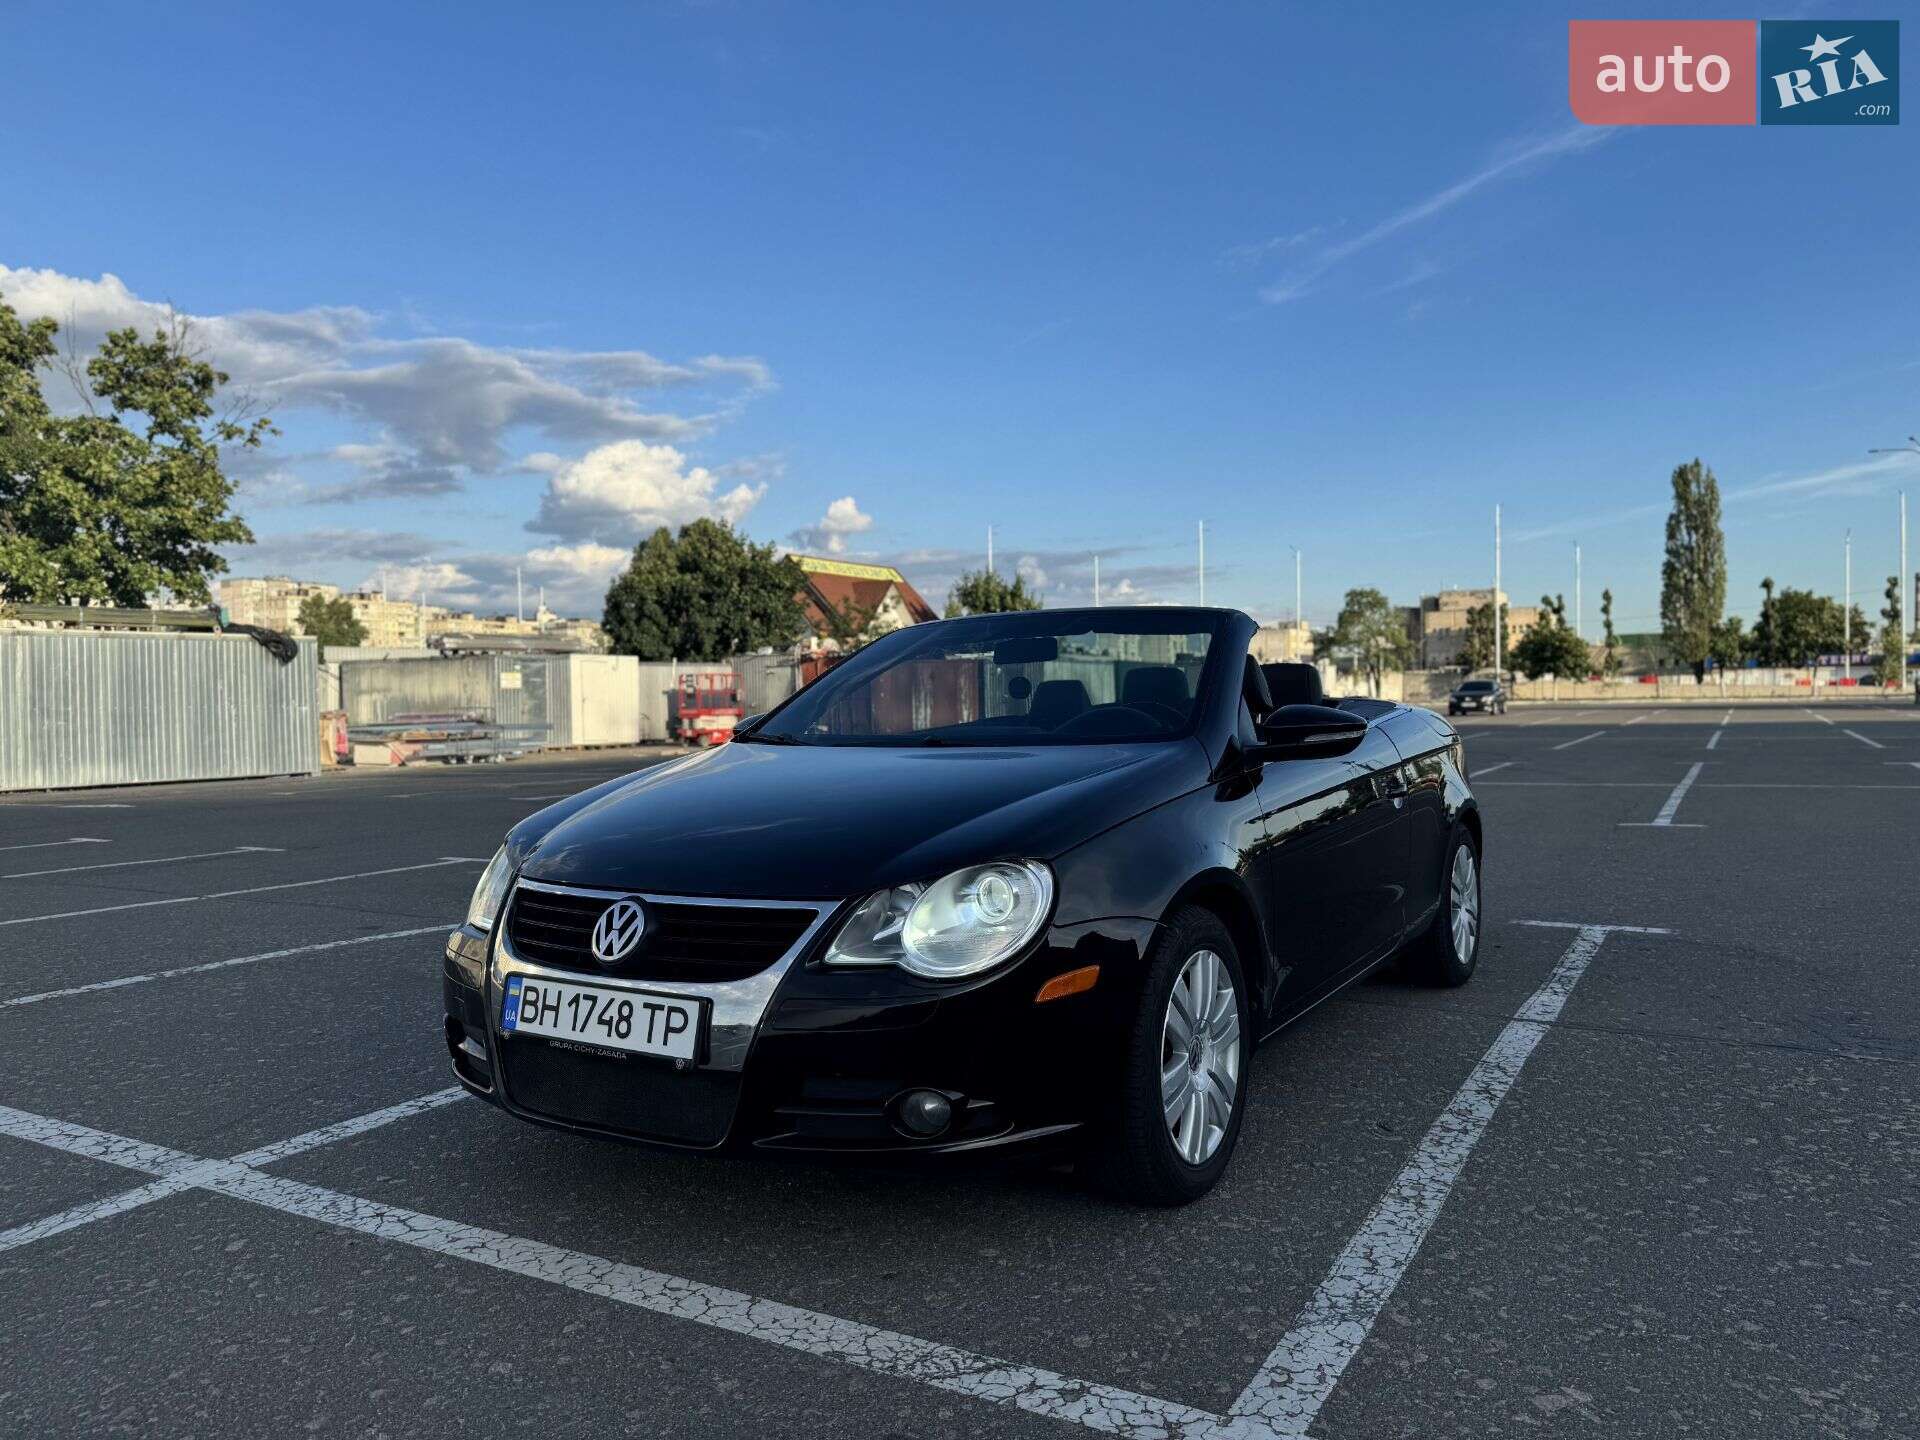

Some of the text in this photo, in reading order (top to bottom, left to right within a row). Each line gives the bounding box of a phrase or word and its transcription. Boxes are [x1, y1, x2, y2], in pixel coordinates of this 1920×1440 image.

[505, 1009, 516, 1022] UA
[519, 986, 689, 1046] BH 1748 TP
[549, 1040, 573, 1050] GRUPA
